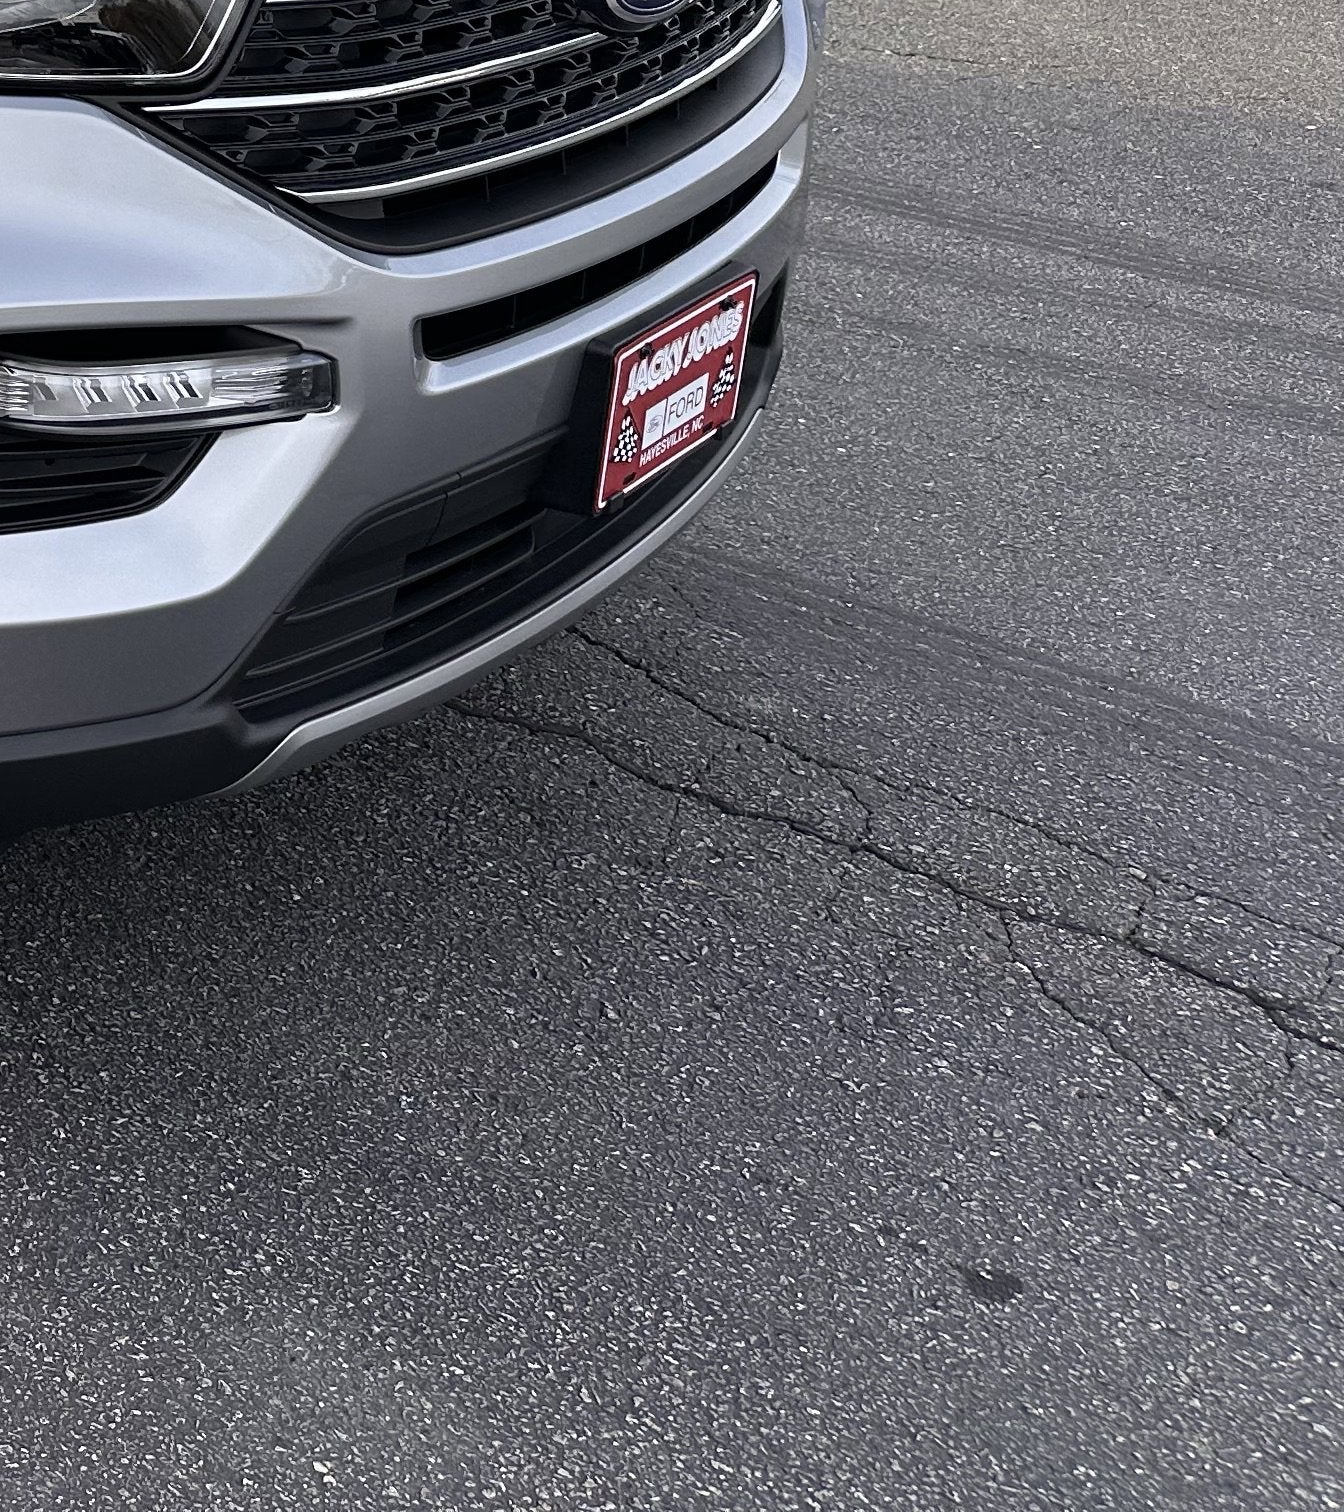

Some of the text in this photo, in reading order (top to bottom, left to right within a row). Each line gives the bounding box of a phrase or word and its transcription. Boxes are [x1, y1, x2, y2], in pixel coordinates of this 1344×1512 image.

[622, 300, 745, 406] JACKY JONES
[667, 385, 704, 425] FORD
[639, 423, 691, 468] HAYESVILLE,
[691, 415, 705, 434] NC
